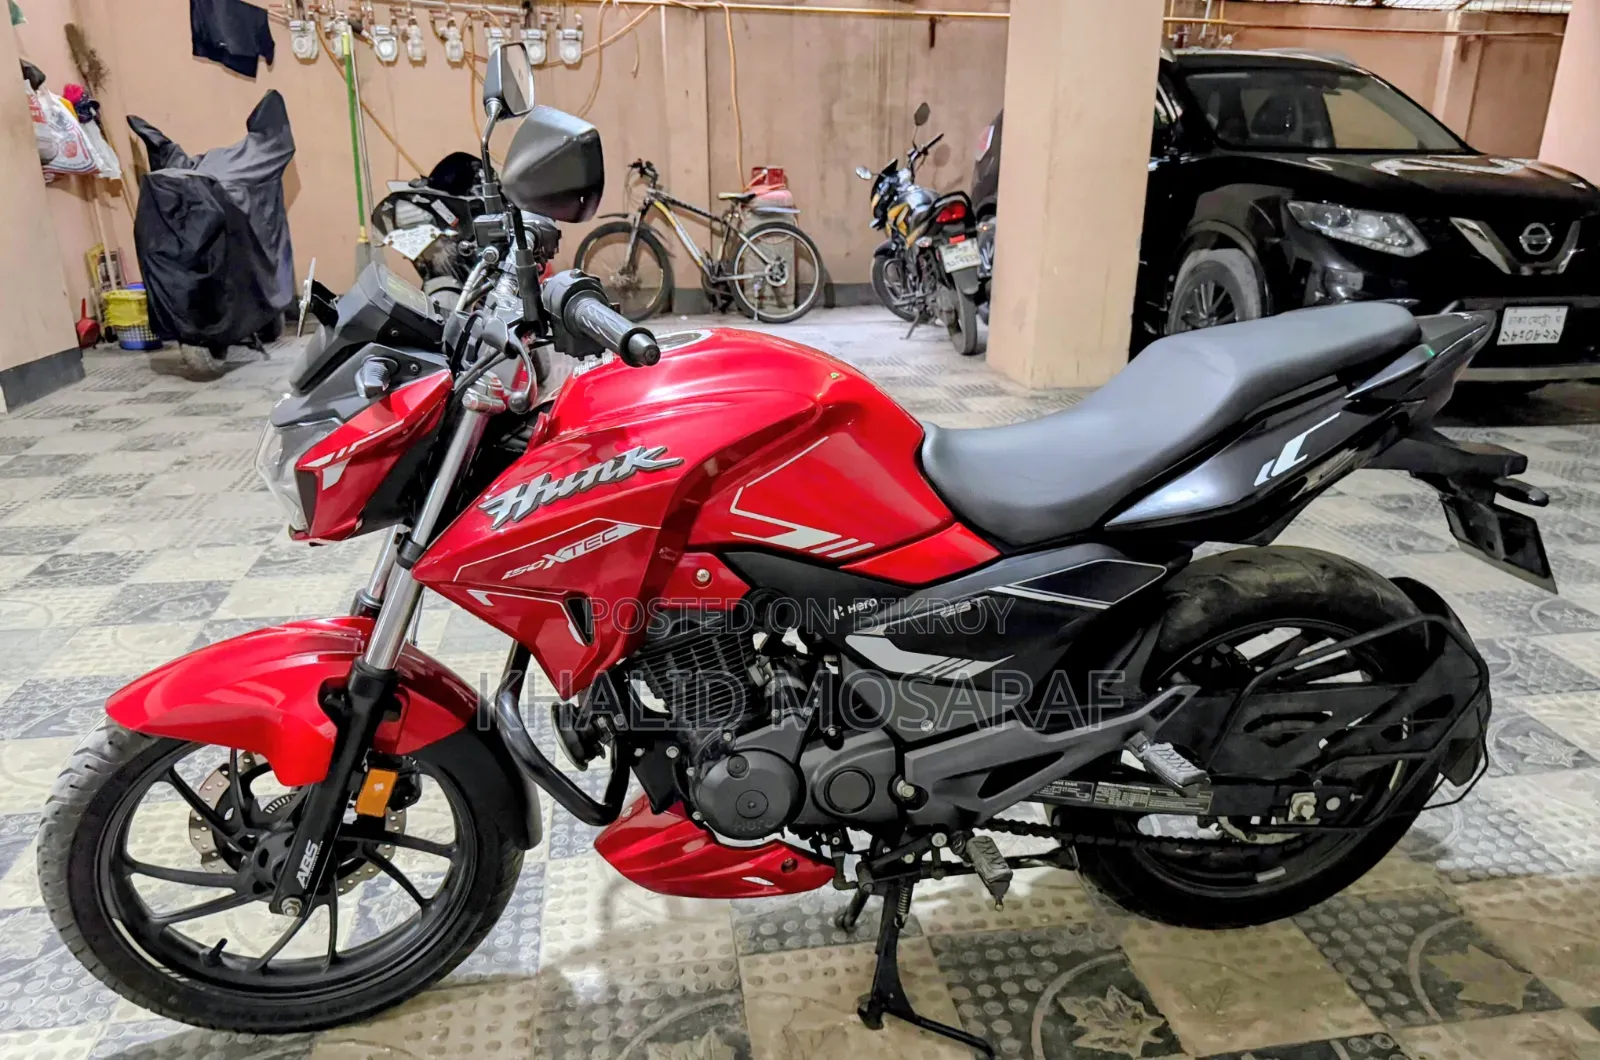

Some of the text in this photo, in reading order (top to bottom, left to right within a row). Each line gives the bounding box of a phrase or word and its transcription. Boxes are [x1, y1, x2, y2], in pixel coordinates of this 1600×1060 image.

[477, 445, 685, 530] Hunk
[847, 598, 878, 614] Hero
[296, 839, 319, 889] ABS
